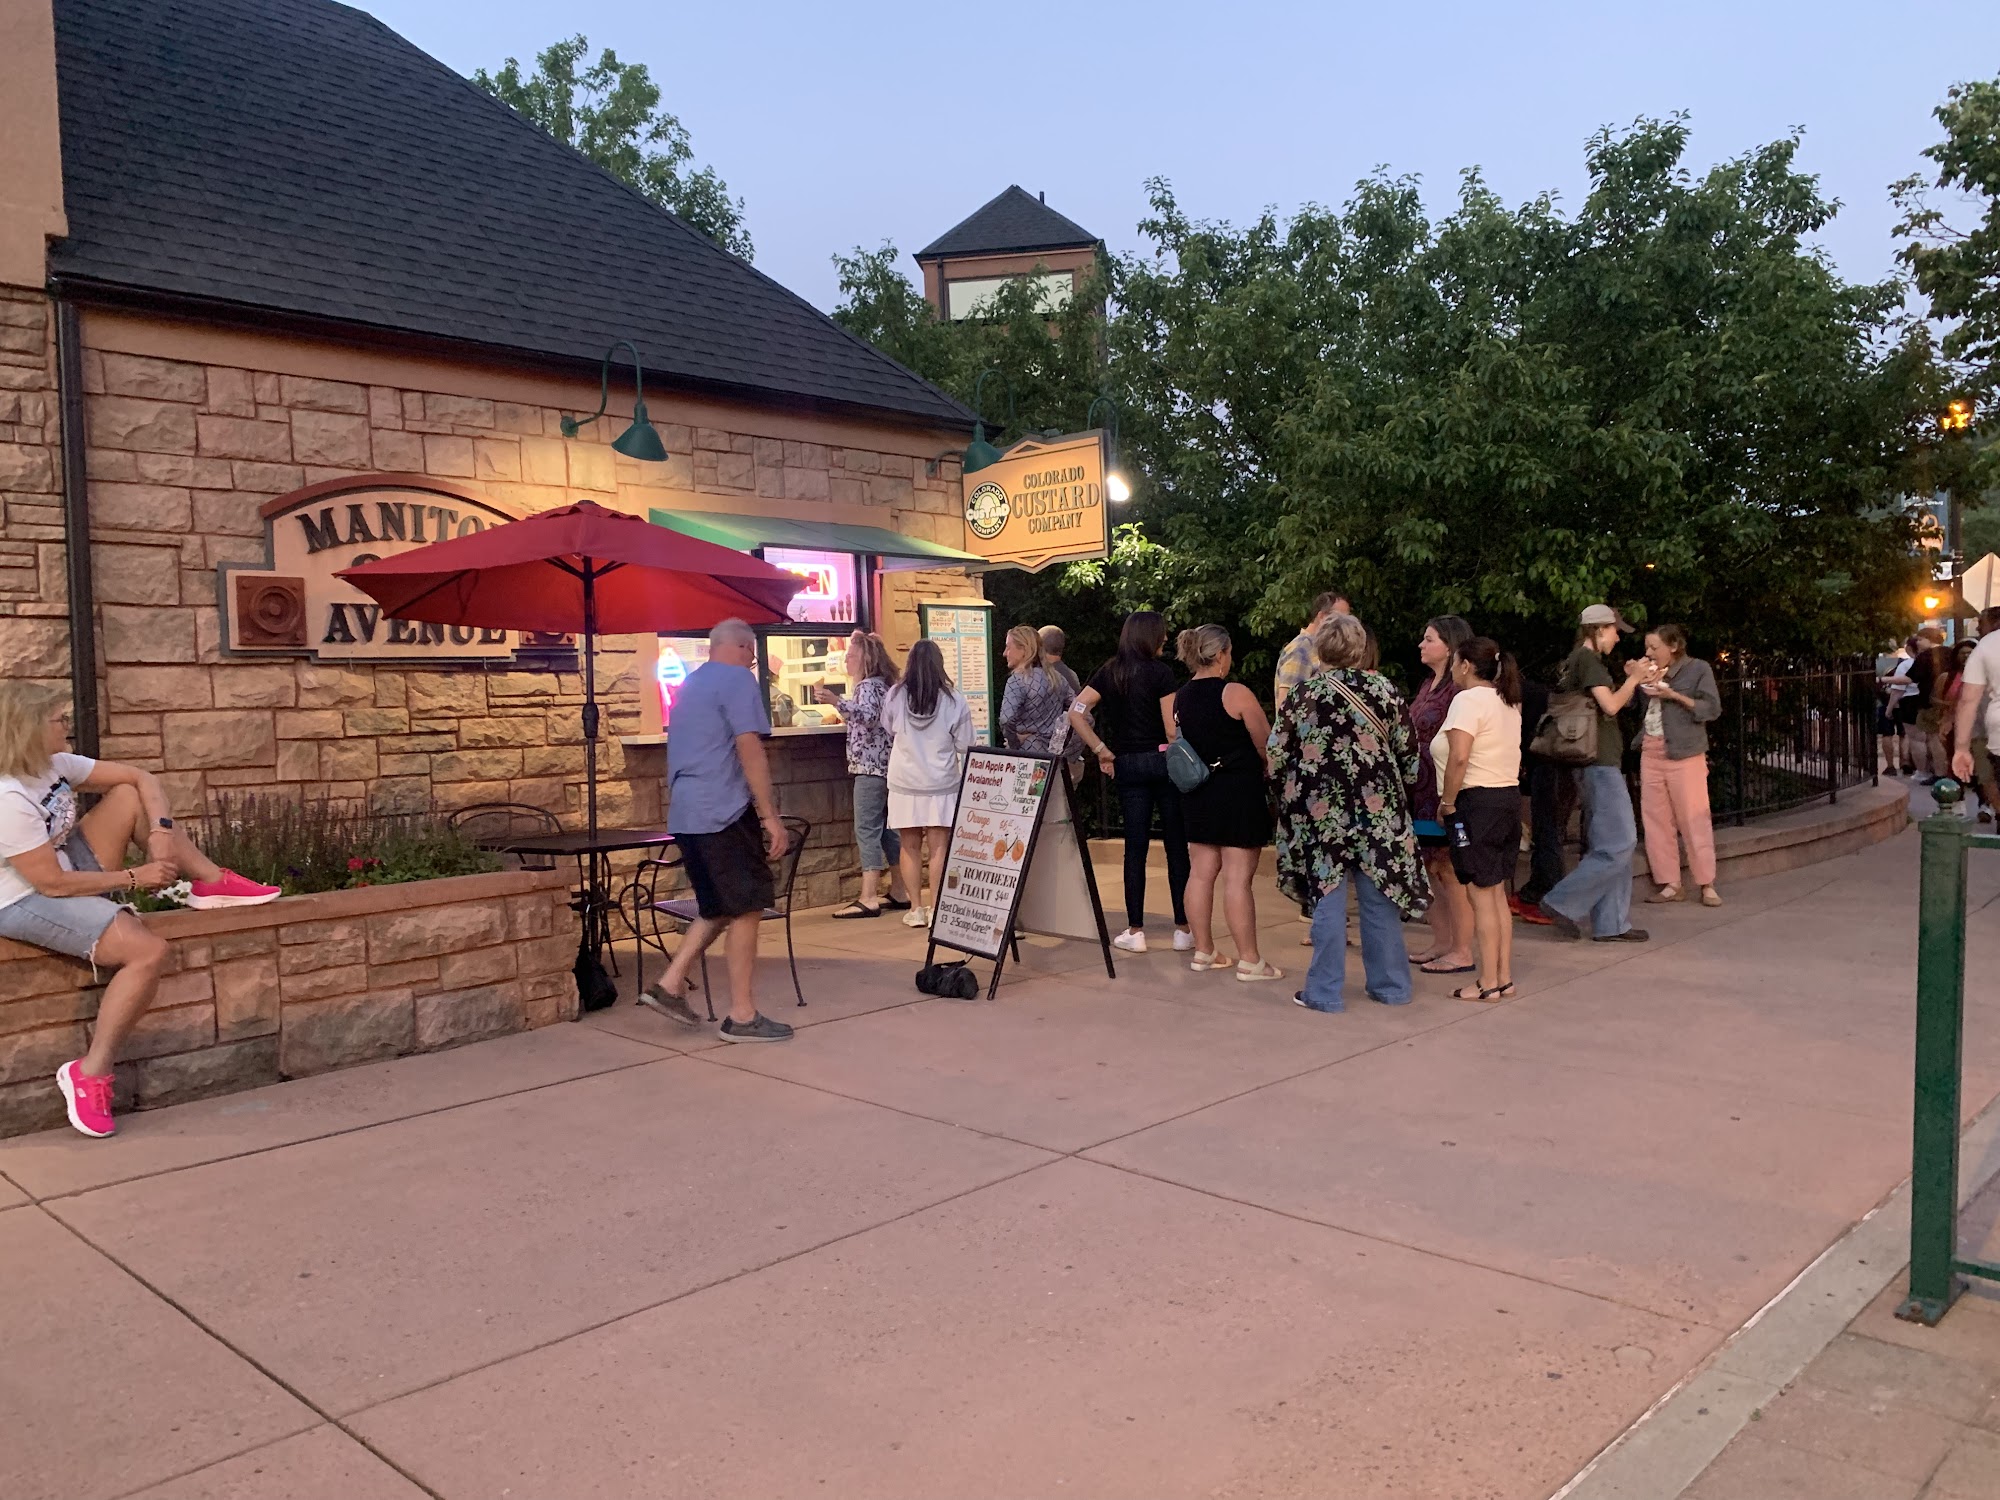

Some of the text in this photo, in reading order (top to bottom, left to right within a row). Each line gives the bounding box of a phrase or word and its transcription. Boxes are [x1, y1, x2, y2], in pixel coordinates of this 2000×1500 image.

[1023, 466, 1084, 489] COLORADO
[971, 485, 1003, 503] COLORADO
[1011, 482, 1100, 519] CUSTARD
[965, 503, 1010, 521] CUSTARD
[294, 501, 500, 554] MANITO
[973, 518, 1003, 535] COMPANY
[1028, 512, 1082, 534] COMPANY
[970, 758, 1017, 774] Real Apple Pie
[967, 773, 1002, 787] Avalanche!
[967, 810, 990, 828] Orange
[964, 867, 1017, 888] ROOTBEER
[960, 884, 992, 900] FLOAT
[952, 904, 966, 915] Deal
